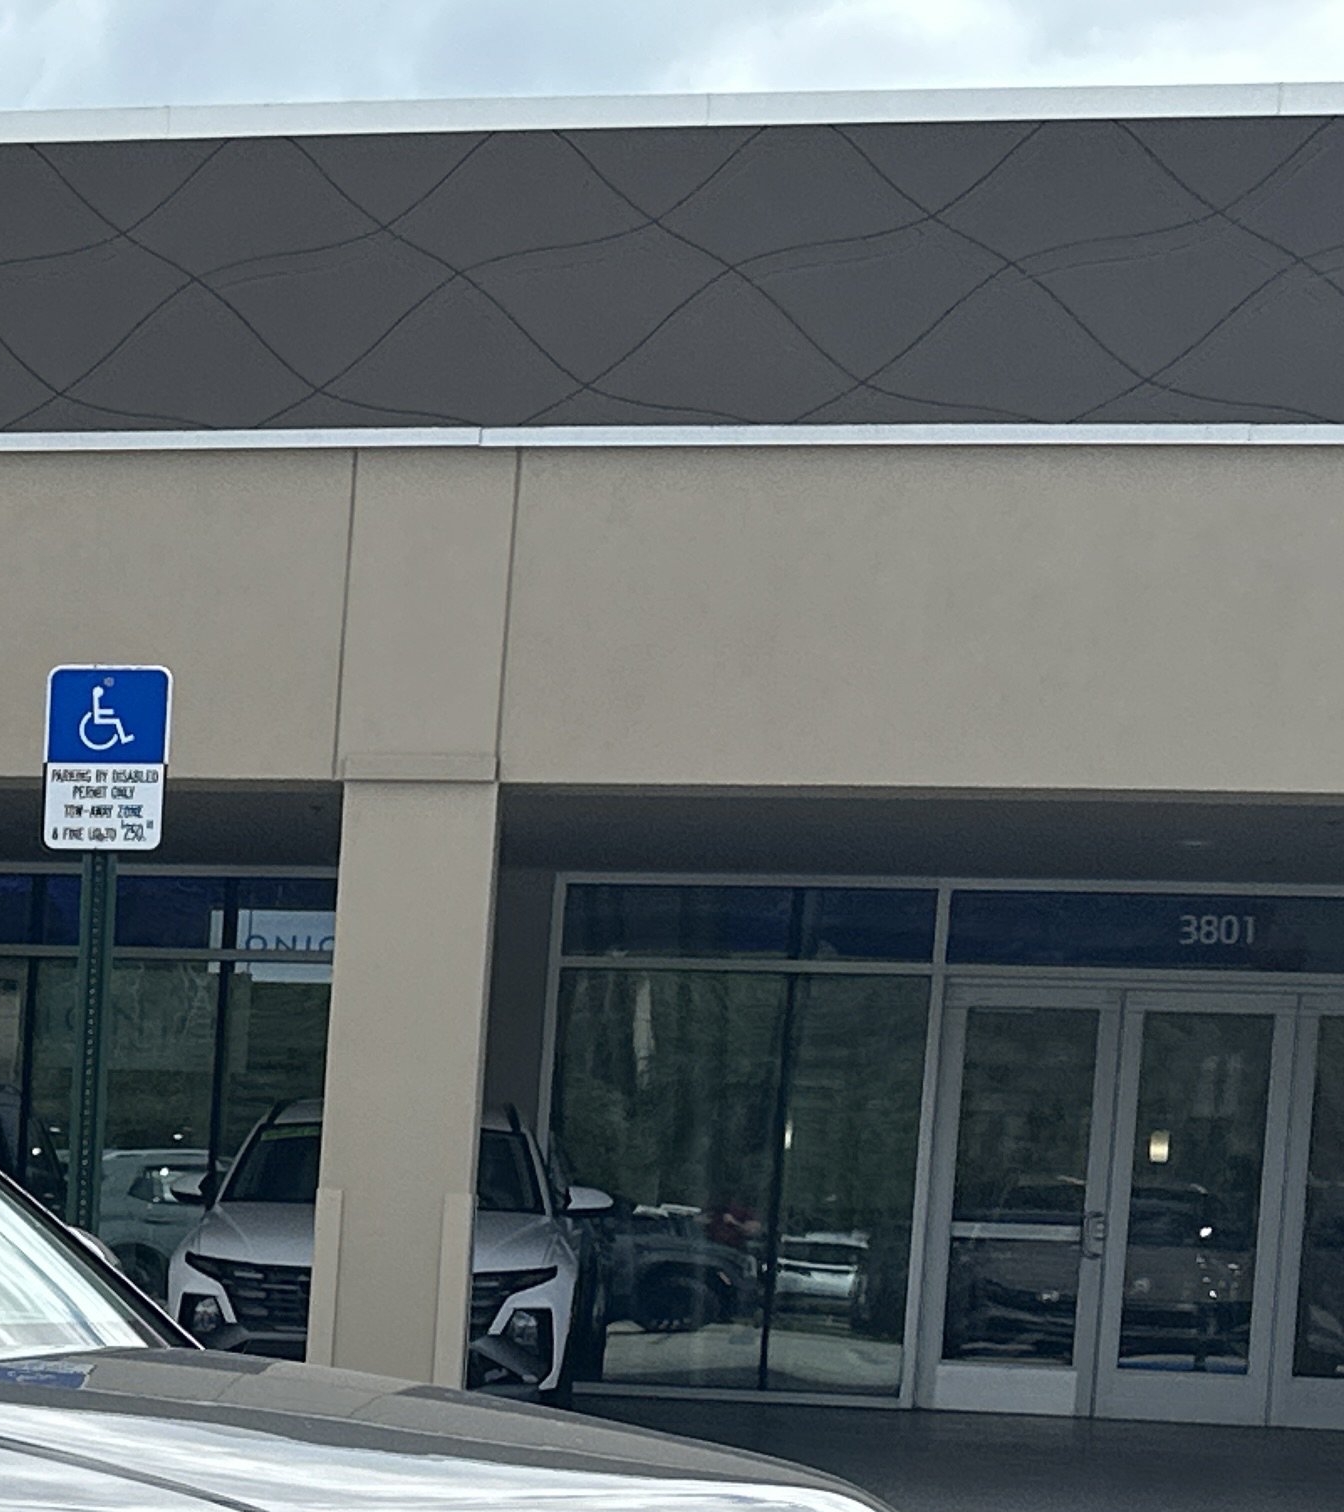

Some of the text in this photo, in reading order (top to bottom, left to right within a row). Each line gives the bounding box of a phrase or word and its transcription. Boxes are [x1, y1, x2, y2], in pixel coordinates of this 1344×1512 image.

[51, 769, 159, 784] PARKING BY DISABLED
[72, 785, 135, 799] PERMIT ONLY
[64, 804, 143, 818] TOW-AWAY ZONE
[1178, 914, 1257, 945] 3801
